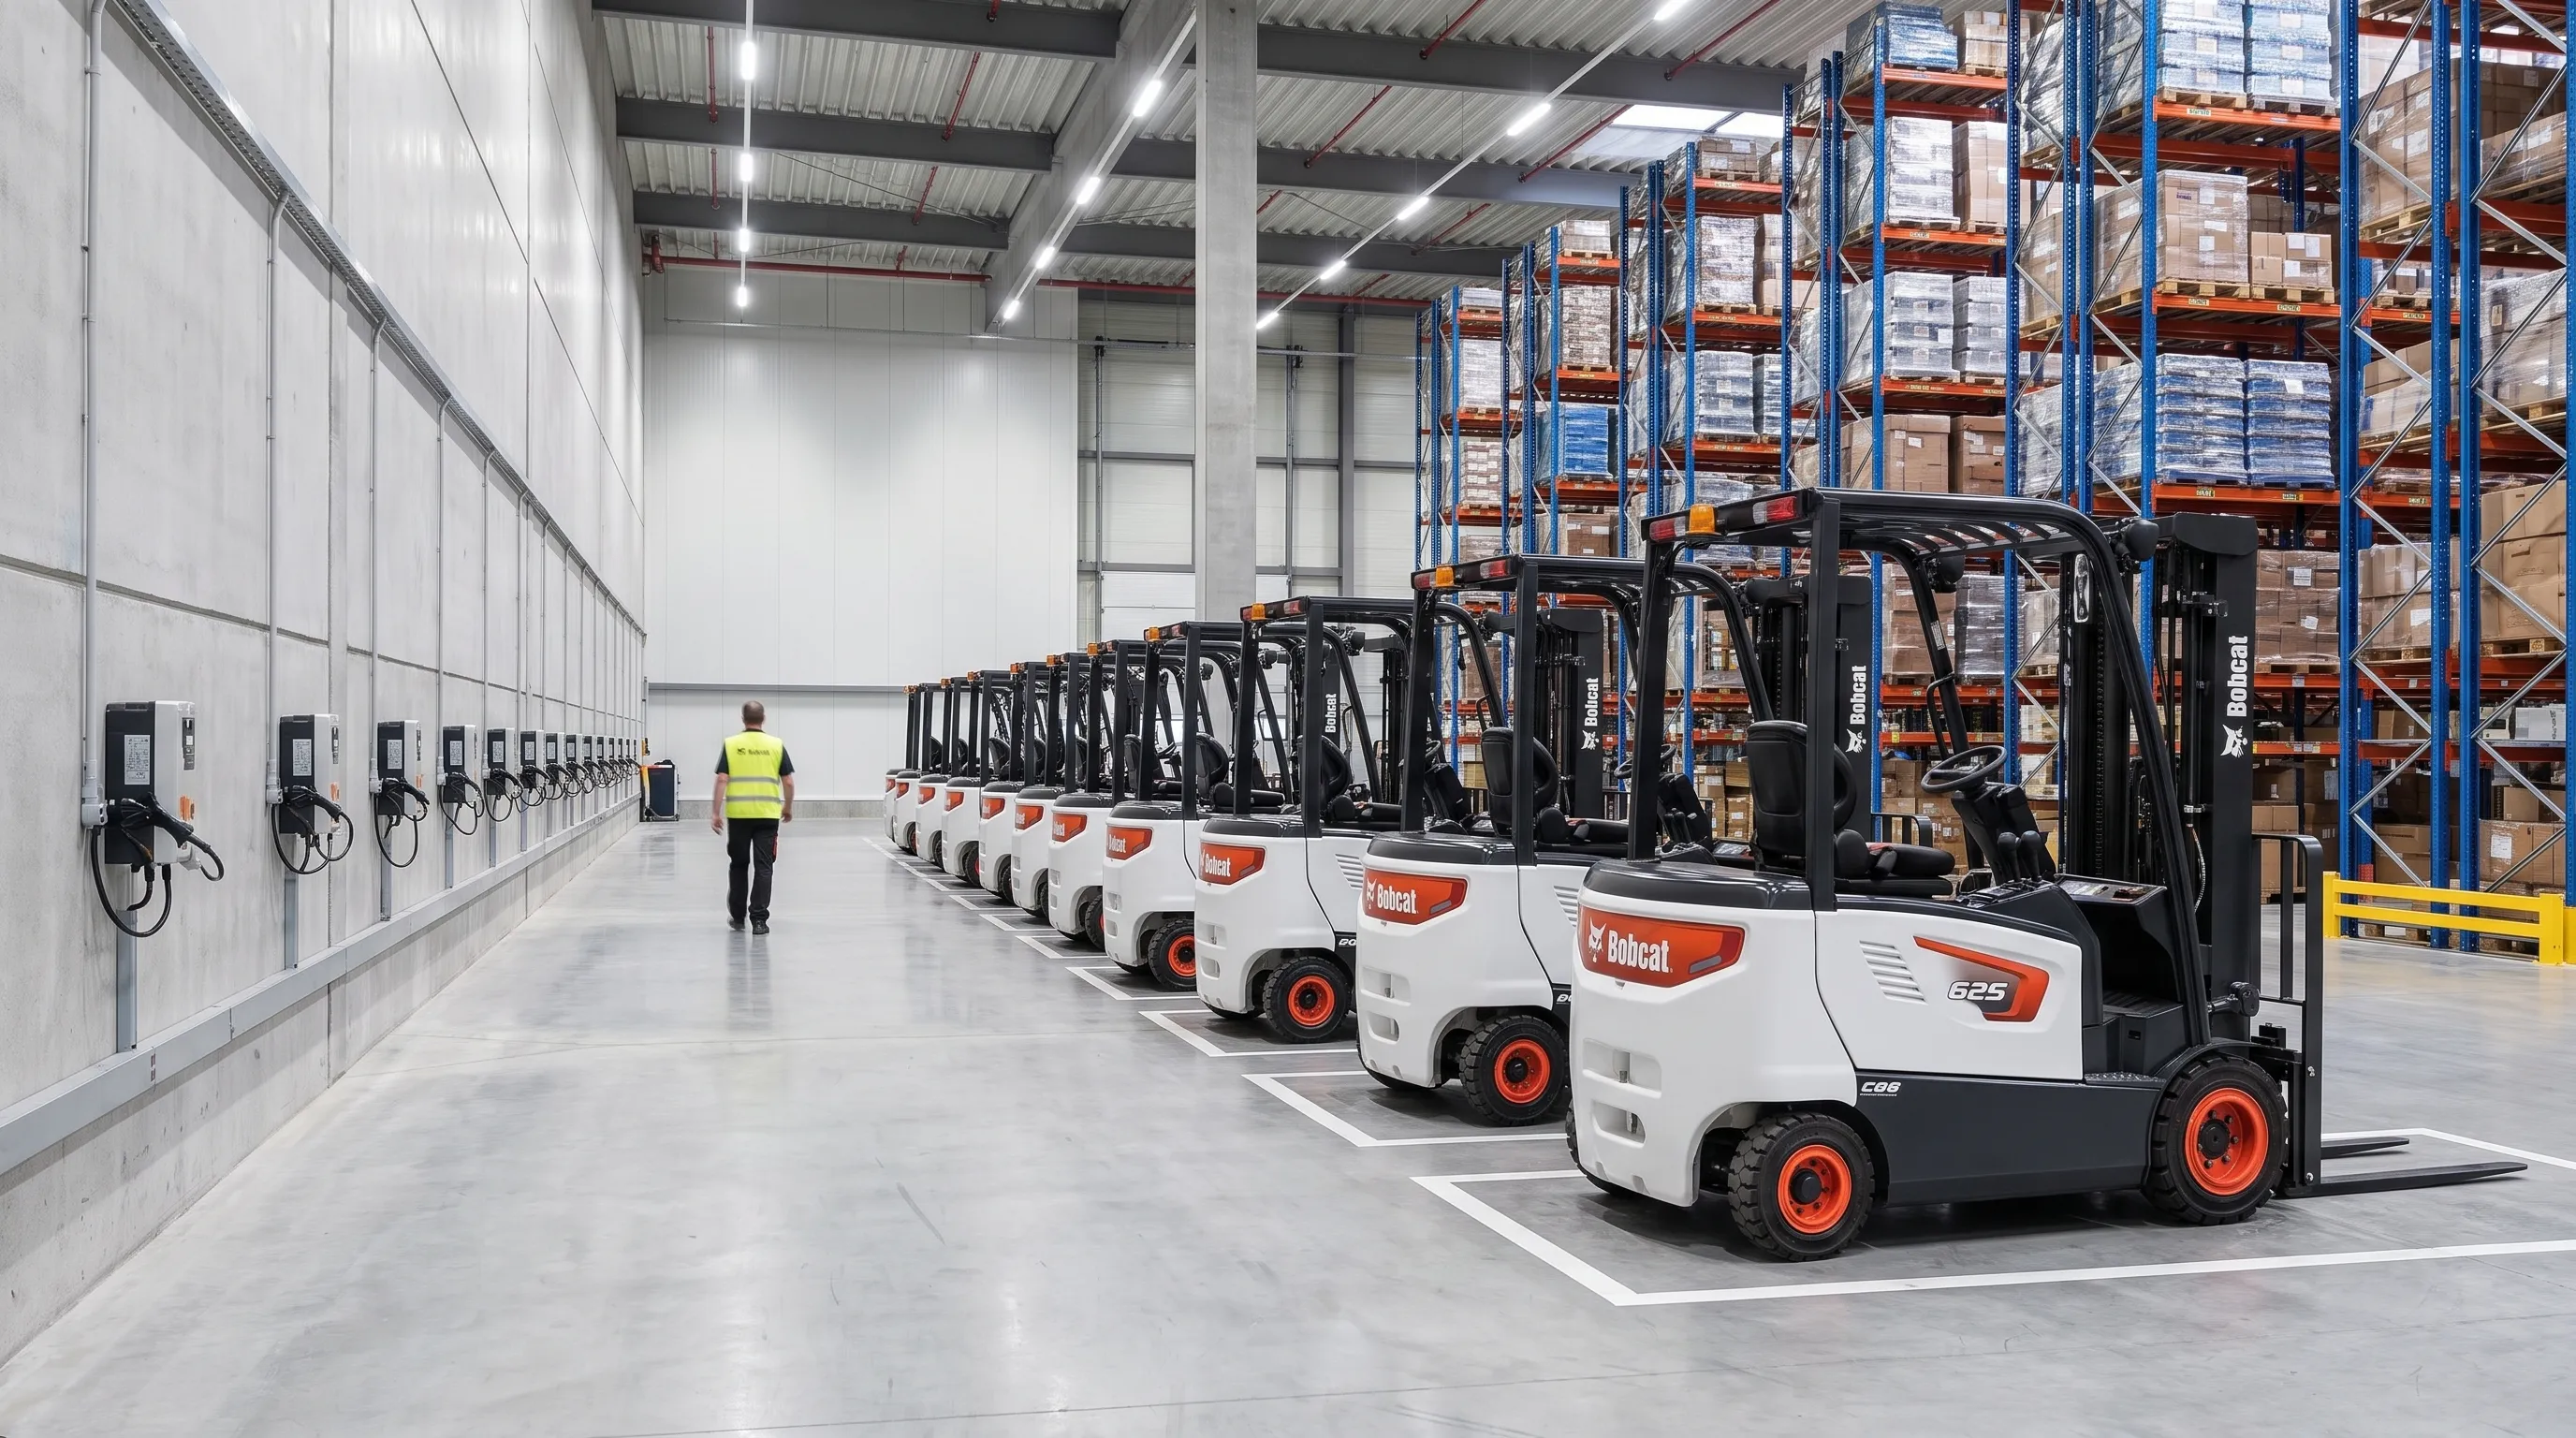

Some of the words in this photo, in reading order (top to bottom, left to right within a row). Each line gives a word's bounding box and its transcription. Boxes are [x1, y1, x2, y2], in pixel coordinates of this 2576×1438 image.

[1850, 666, 1866, 725] Bobcat
[2227, 636, 2247, 717] Bobcat
[1377, 883, 1417, 914] Bobcat
[1608, 930, 1670, 973] Bobcat
[1948, 981, 2009, 1001] 625
